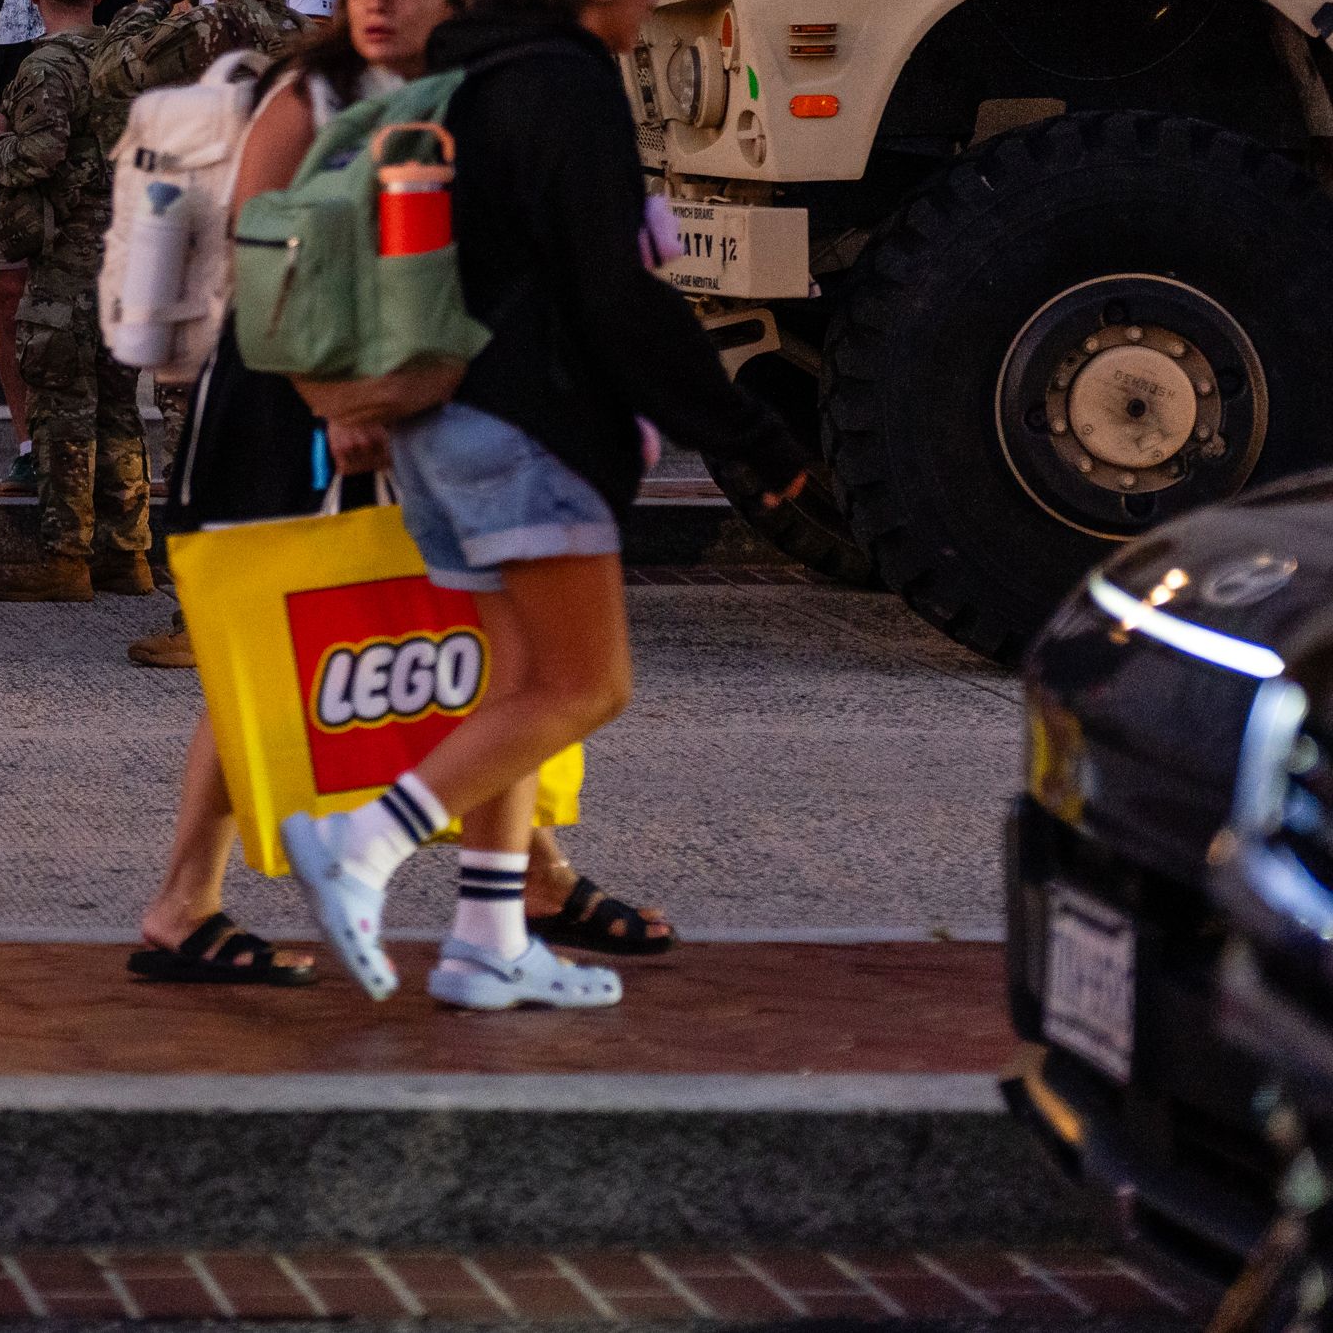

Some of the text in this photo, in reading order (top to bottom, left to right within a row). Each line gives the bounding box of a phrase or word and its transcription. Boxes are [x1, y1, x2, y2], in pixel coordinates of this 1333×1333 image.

[693, 208, 715, 220] BRAKE
[677, 232, 738, 262] ATV 12
[692, 275, 721, 291] NEUTRAL
[317, 629, 484, 728] LEGO
